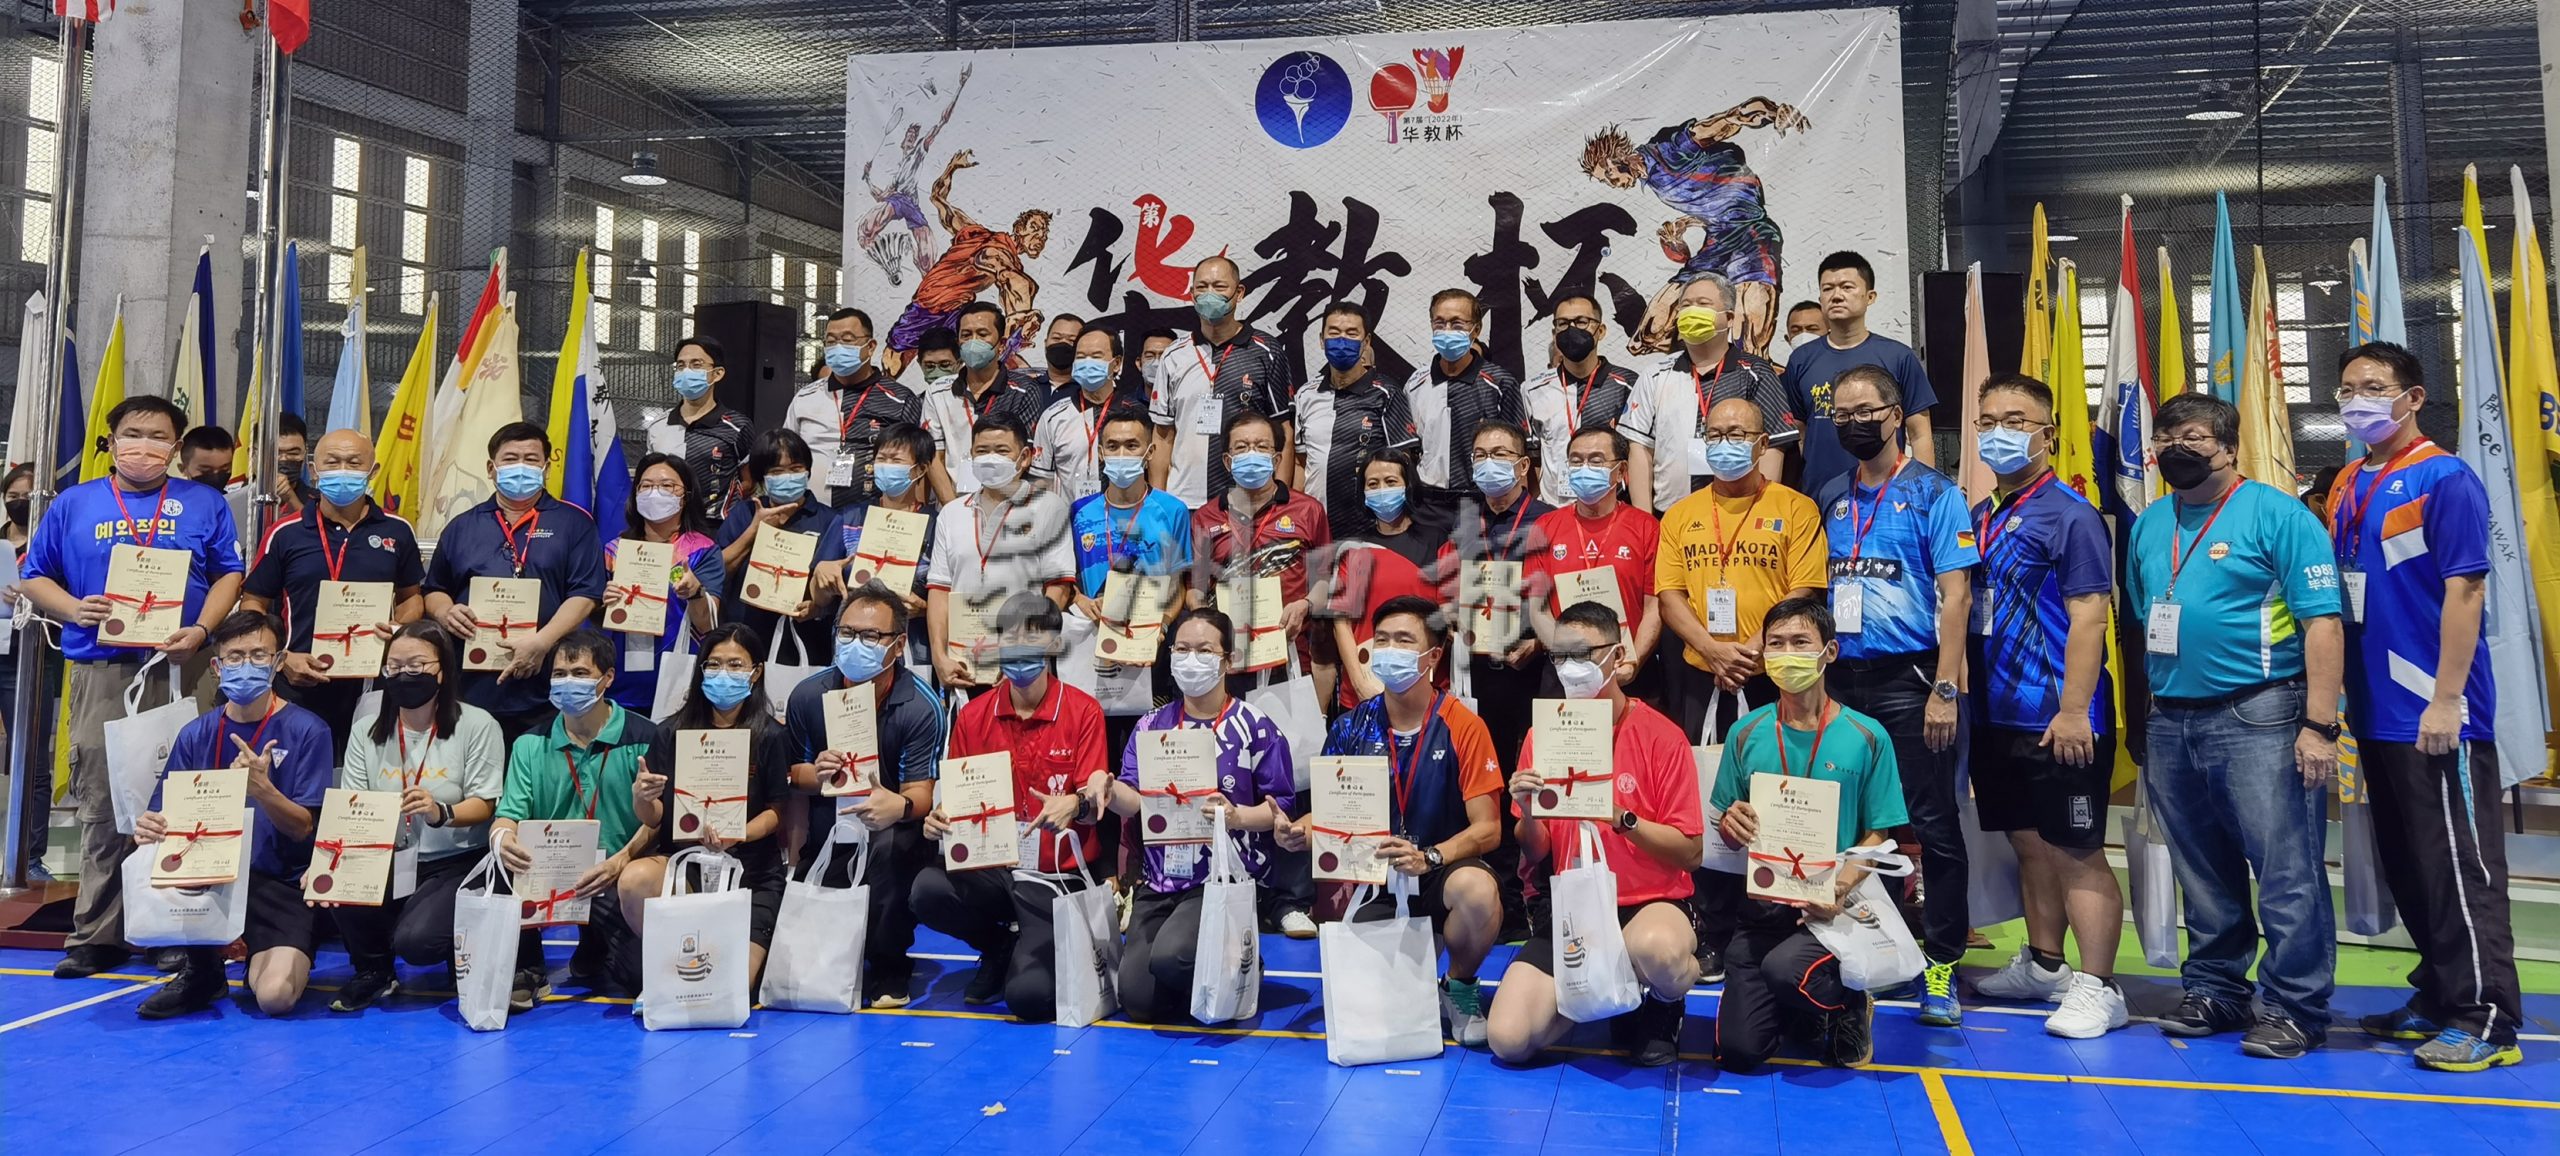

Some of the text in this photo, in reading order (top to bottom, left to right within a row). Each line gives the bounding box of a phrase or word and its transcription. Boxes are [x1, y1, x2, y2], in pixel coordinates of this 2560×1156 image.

[1402, 124, 1463, 143] 华教杯
[1736, 540, 1778, 558] KOTA
[1686, 556, 1778, 572] ENTERPRISE
